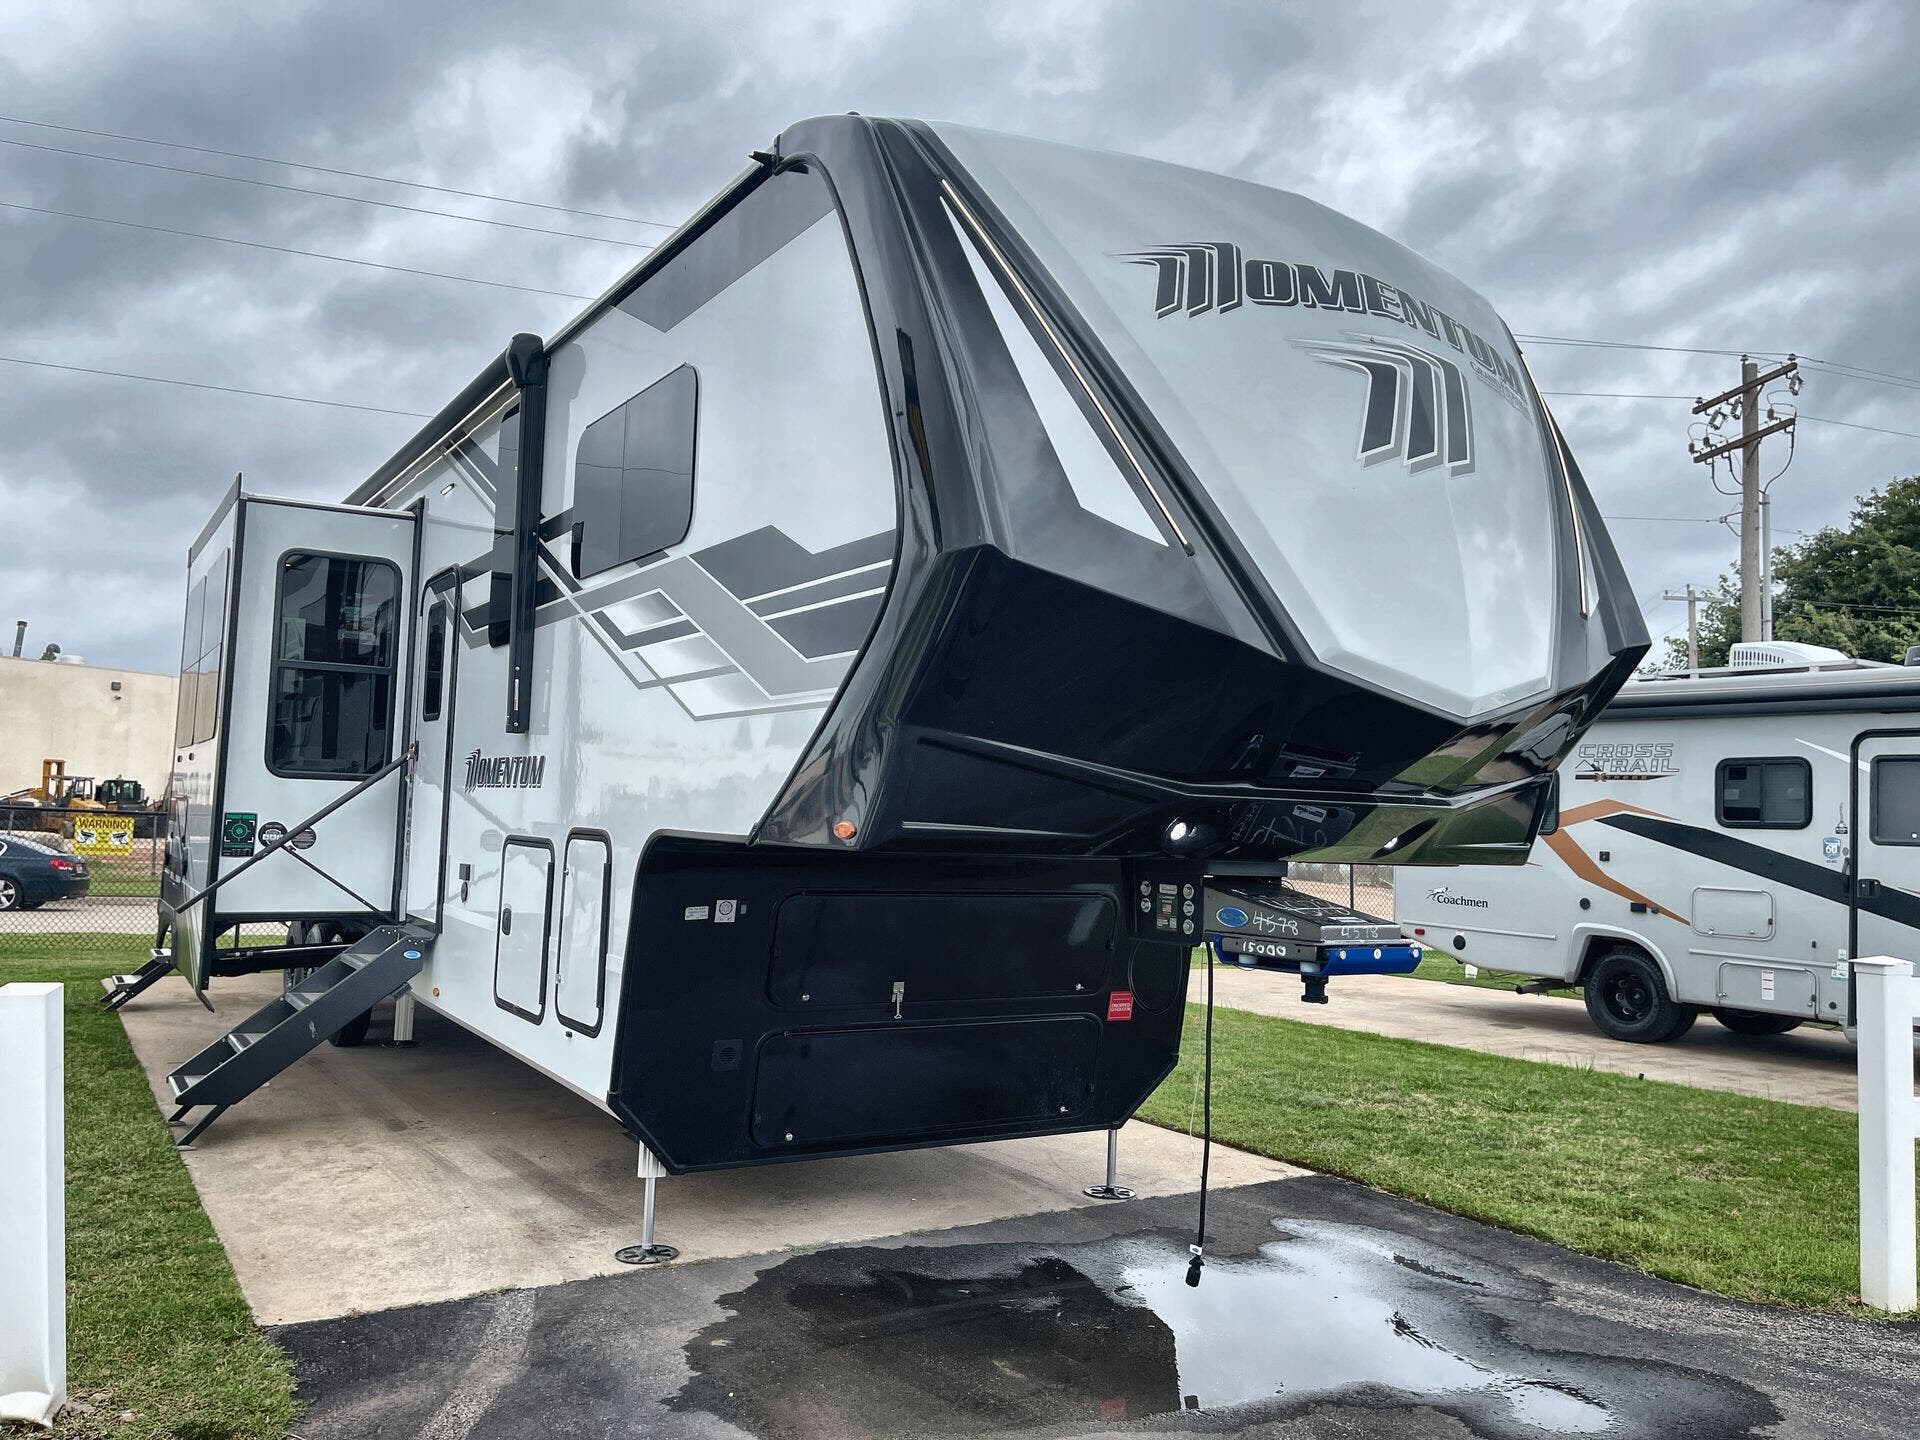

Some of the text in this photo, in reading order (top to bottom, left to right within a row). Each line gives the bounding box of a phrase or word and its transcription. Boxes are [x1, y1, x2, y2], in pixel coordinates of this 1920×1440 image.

[1578, 743, 1674, 758] CROSS
[464, 748, 546, 793] MOMENTUM
[1594, 758, 1680, 773] TRAIL
[79, 817, 131, 830] WARNING!
[1436, 894, 1489, 909] Coachmen
[1252, 910, 1299, 936] 4578
[1340, 926, 1379, 940] 4578
[1241, 941, 1287, 957] 15000
